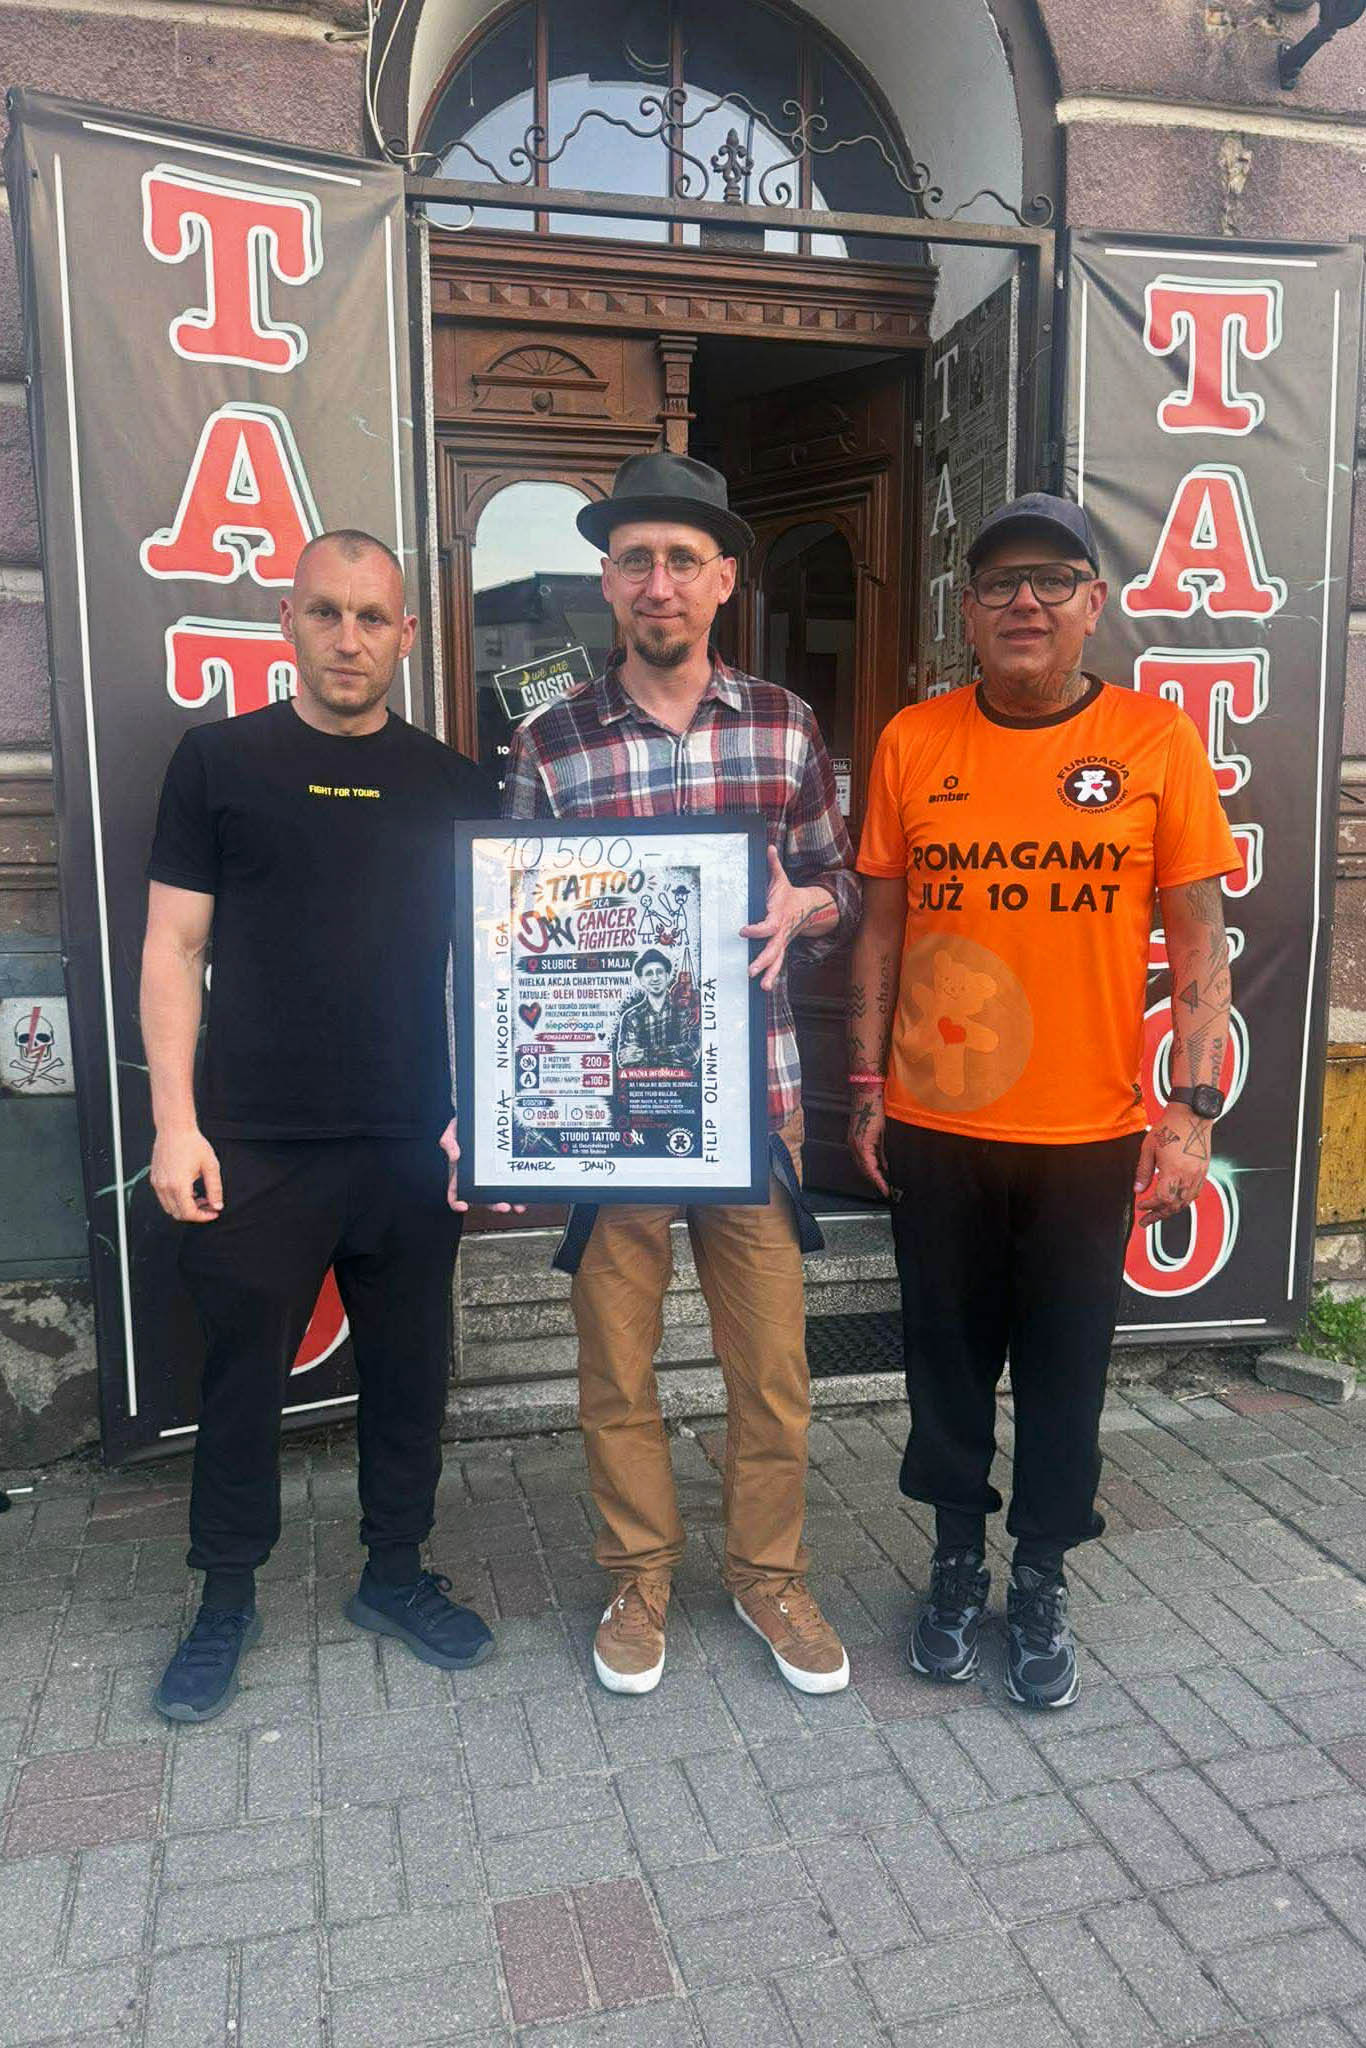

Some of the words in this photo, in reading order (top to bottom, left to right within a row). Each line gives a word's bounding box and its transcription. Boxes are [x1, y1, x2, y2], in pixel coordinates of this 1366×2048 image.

[1057, 756, 1129, 780] FUNDACJA
[308, 785, 332, 796] FIGHT
[334, 788, 351, 797] FOR
[352, 788, 380, 798] YOURS
[912, 841, 1131, 872] POMAGAMY
[546, 869, 646, 901] TATTOO
[919, 874, 964, 912] JUŻ
[987, 884, 1029, 911] 10
[1050, 883, 1120, 913] LAT
[576, 907, 637, 931] CANCER
[577, 928, 637, 951] FIGHTERS
[541, 958, 577, 970] SŁUBICE
[607, 958, 631, 969] MAJA
[519, 978, 546, 987] WIELKA
[548, 977, 571, 986] AKCJA
[497, 988, 510, 1069] NIKODEM
[585, 1056, 602, 1068] 200
[537, 1110, 559, 1120] 09:00
[560, 1131, 590, 1142] STUDIO
[592, 1131, 621, 1142] TATTOO
[507, 1160, 556, 1173] FRANEK
